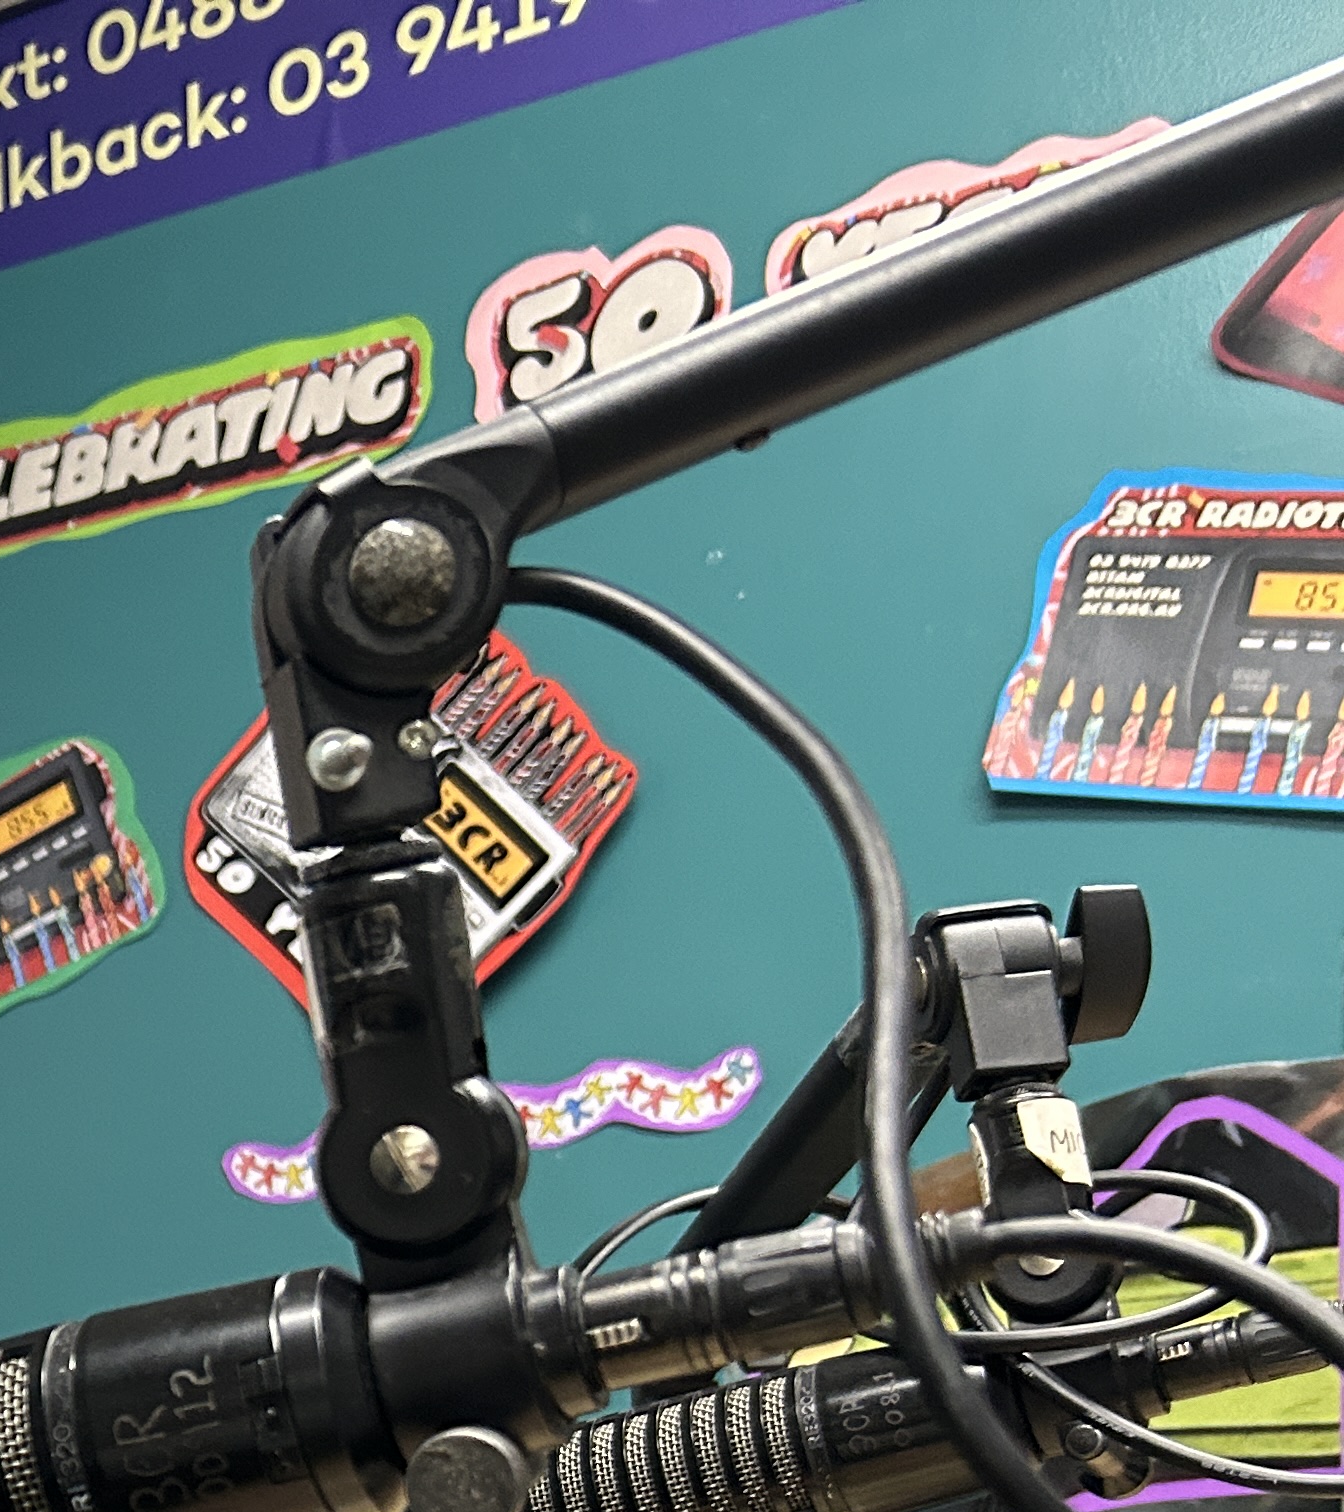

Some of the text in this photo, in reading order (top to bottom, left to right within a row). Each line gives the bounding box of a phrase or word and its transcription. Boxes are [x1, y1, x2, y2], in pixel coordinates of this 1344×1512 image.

[268, 29, 372, 117] 03
[1108, 500, 1187, 528] 3CR
[196, 838, 257, 894] 50
[431, 803, 509, 873] 3CR
